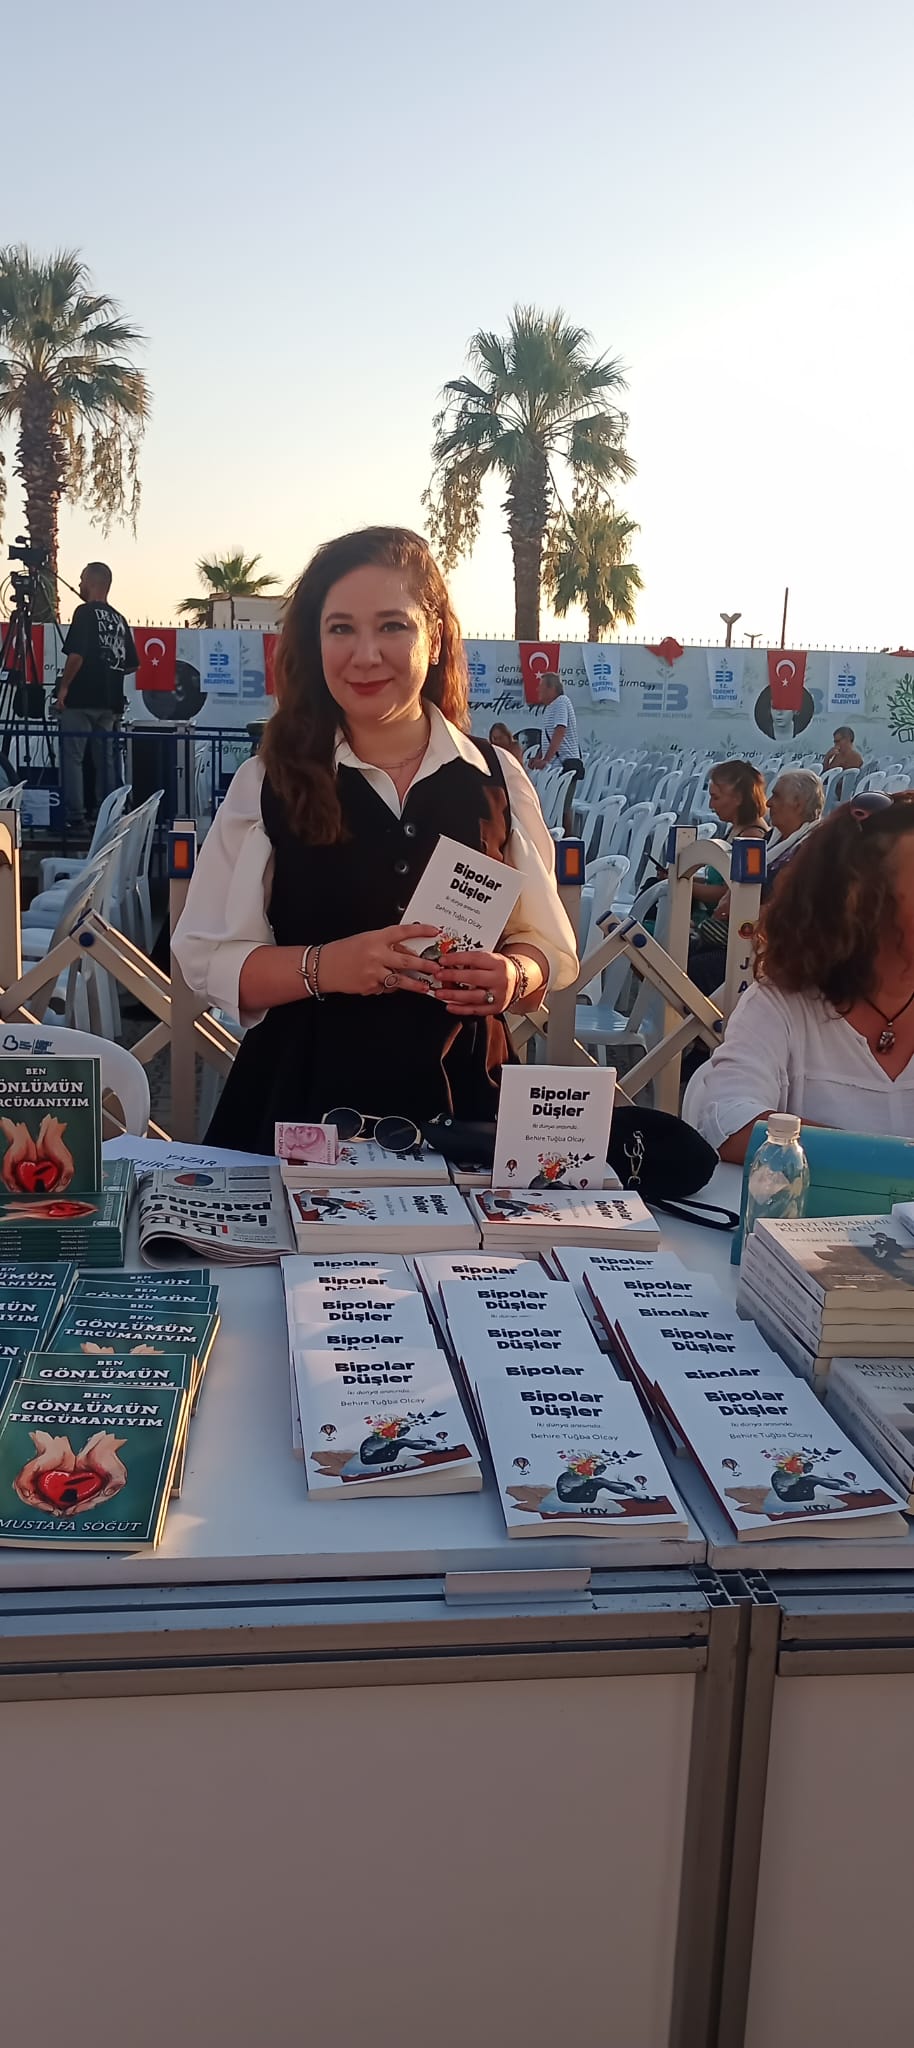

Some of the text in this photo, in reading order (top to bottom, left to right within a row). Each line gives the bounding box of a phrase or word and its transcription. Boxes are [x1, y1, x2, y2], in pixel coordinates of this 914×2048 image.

[453, 862, 502, 891] Bipolar
[450, 878, 492, 904] Düşler
[0, 1079, 84, 1093] ÖNLÜMÜN
[529, 1086, 590, 1102] Bipolar
[0, 1096, 89, 1107] CÜMANIYIM
[532, 1103, 584, 1119] Düşler
[525, 1134, 585, 1143] Behire Tuğba Olcay
[166, 1154, 218, 1166] YAZAR
[150, 1194, 271, 1211] patrona
[429, 1195, 448, 1215] Bipolar
[313, 1260, 379, 1269] Bipolar
[589, 1256, 655, 1266] Bipolar
[451, 1265, 518, 1276] Bipolar
[318, 1276, 388, 1287] Bipolar
[623, 1280, 693, 1291] Bipolar
[477, 1289, 549, 1300] Bipolar
[322, 1301, 396, 1311] Bipolar
[485, 1300, 547, 1312] Düşler
[329, 1311, 393, 1323] Düşler
[638, 1308, 711, 1318] Bipolar
[75, 1318, 195, 1334] GÖNLÜMÜN
[64, 1328, 198, 1343] TERCÜMANIYIM
[487, 1327, 562, 1339] Bipolar
[660, 1328, 735, 1341] Bipolar
[327, 1334, 404, 1346] Bipolar
[497, 1339, 562, 1352] Düşler
[671, 1341, 736, 1354] Düşler
[39, 1367, 170, 1379] GÖNLÜMÜN
[334, 1361, 415, 1373] Bipolar
[505, 1365, 585, 1377] Bipolar
[685, 1367, 760, 1378] Bipolar
[342, 1373, 413, 1386] Düşler
[83, 1392, 112, 1400] BEN
[520, 1390, 604, 1403] Bipolar
[704, 1390, 785, 1403] Bipolar
[21, 1399, 160, 1415] GÖNLÜMÜN
[530, 1404, 603, 1419] Düşler
[718, 1404, 789, 1418] Düşler
[9, 1413, 164, 1427] TERCÜMANIYIM
[592, 1433, 619, 1441] Olcay
[0, 1519, 76, 1531] MUSTAFA
